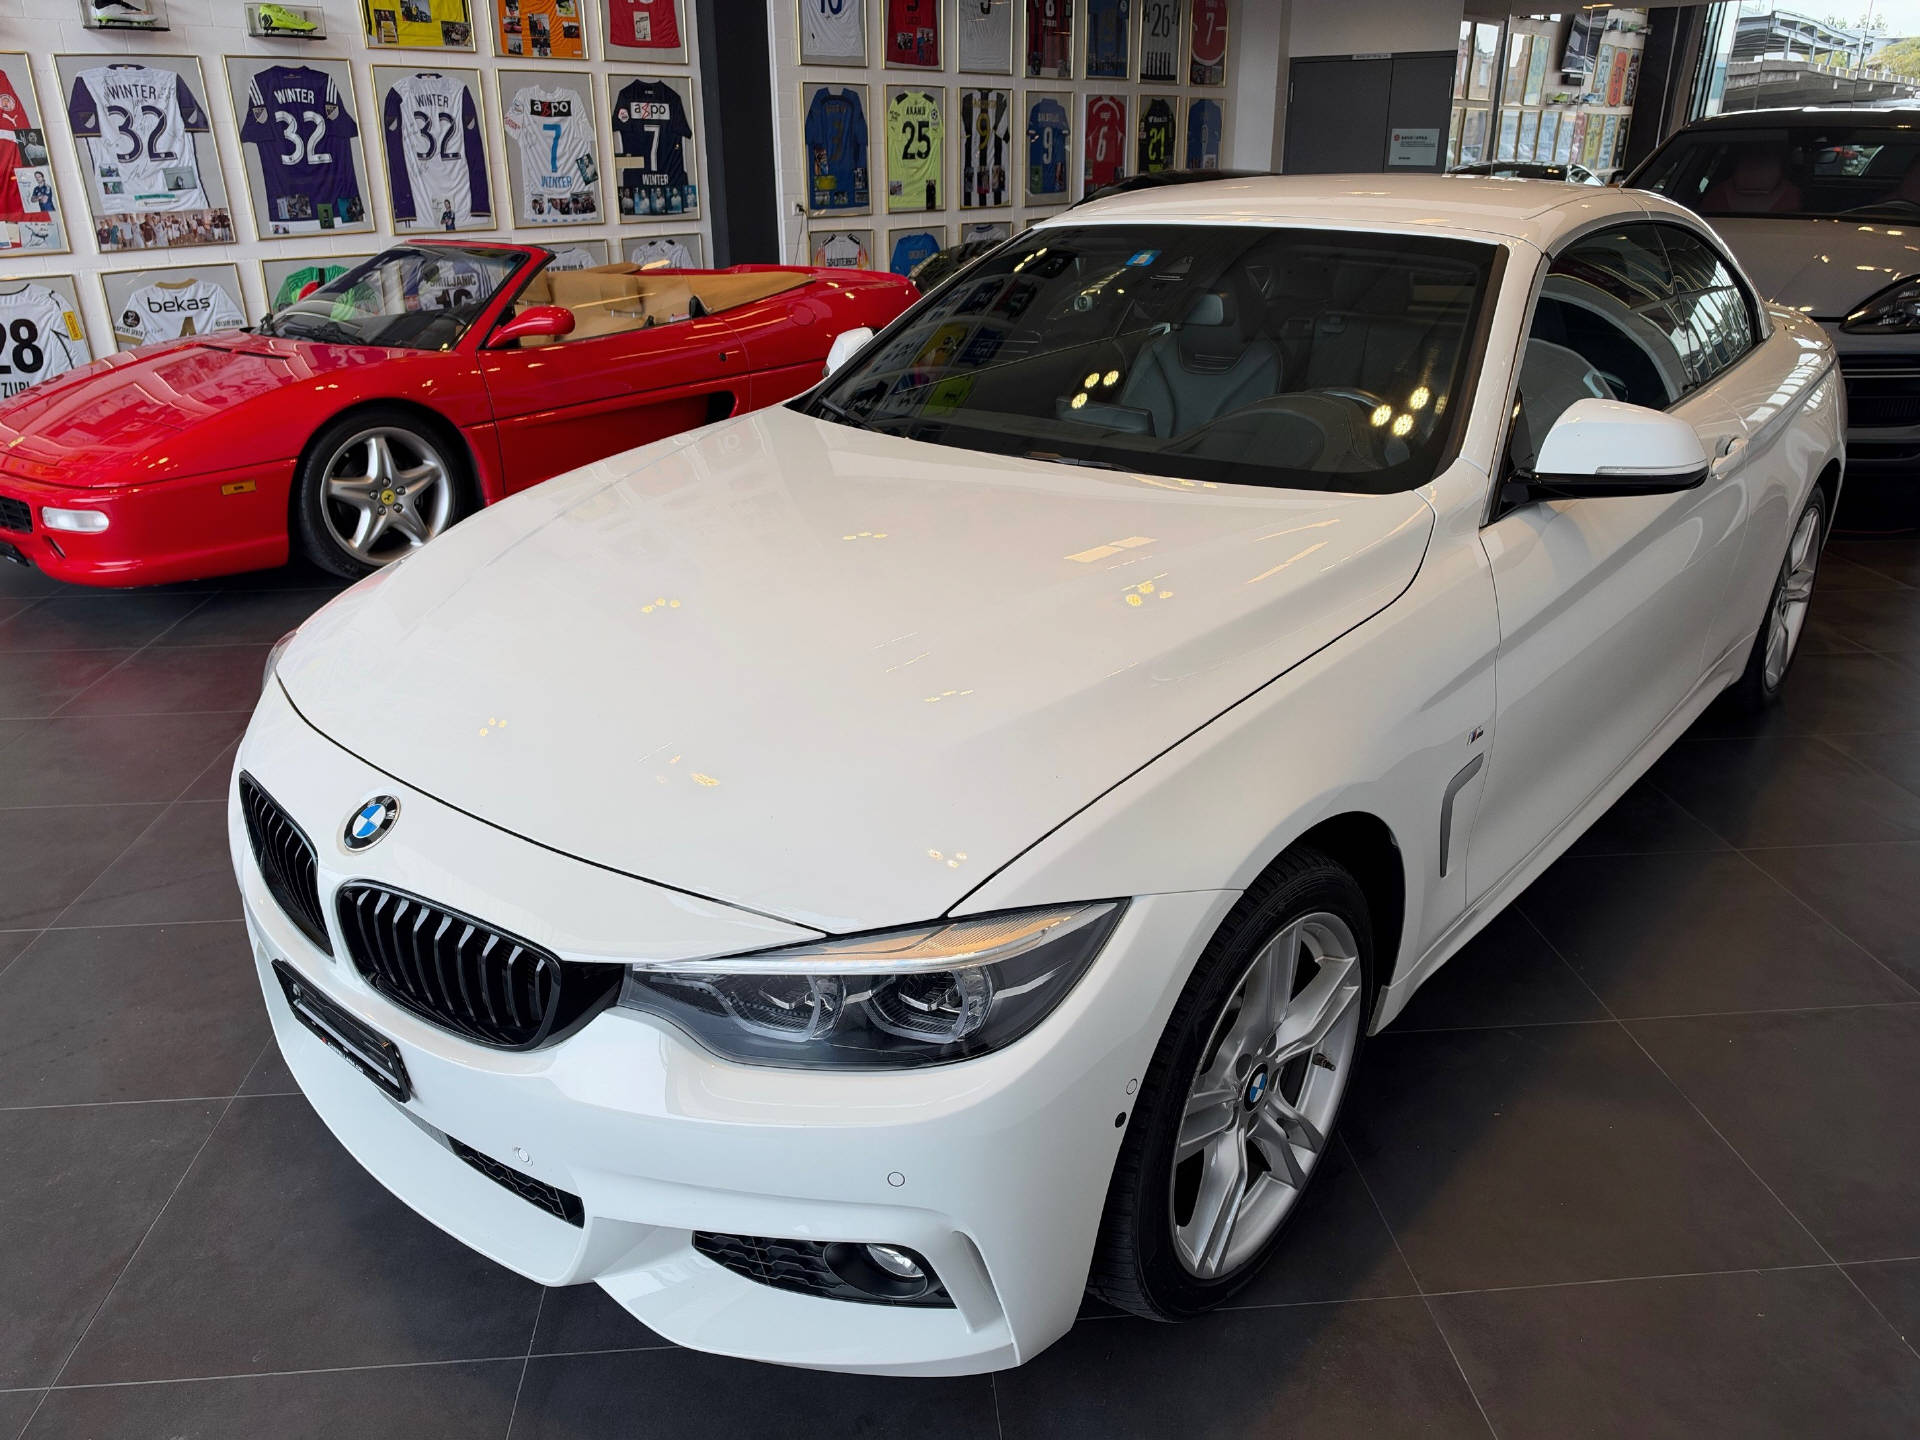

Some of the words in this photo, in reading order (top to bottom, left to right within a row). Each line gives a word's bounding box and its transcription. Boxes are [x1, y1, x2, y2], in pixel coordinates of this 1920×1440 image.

[1151, 3, 1171, 38] 26
[1206, 12, 1216, 45] 7
[107, 84, 157, 100] WINTER
[274, 88, 315, 105] WINTER
[415, 94, 449, 108] WINTER
[106, 105, 178, 163] 32
[274, 111, 333, 165] 32
[414, 111, 461, 161] 32
[543, 124, 561, 173] 7
[644, 125, 660, 171] 7
[902, 121, 931, 160] 25
[976, 112, 990, 150] 9
[1043, 127, 1053, 164] 9
[1096, 126, 1108, 162] 6
[1148, 127, 1165, 161] 21
[541, 176, 573, 188] WINTER
[642, 174, 669, 186] WINTER
